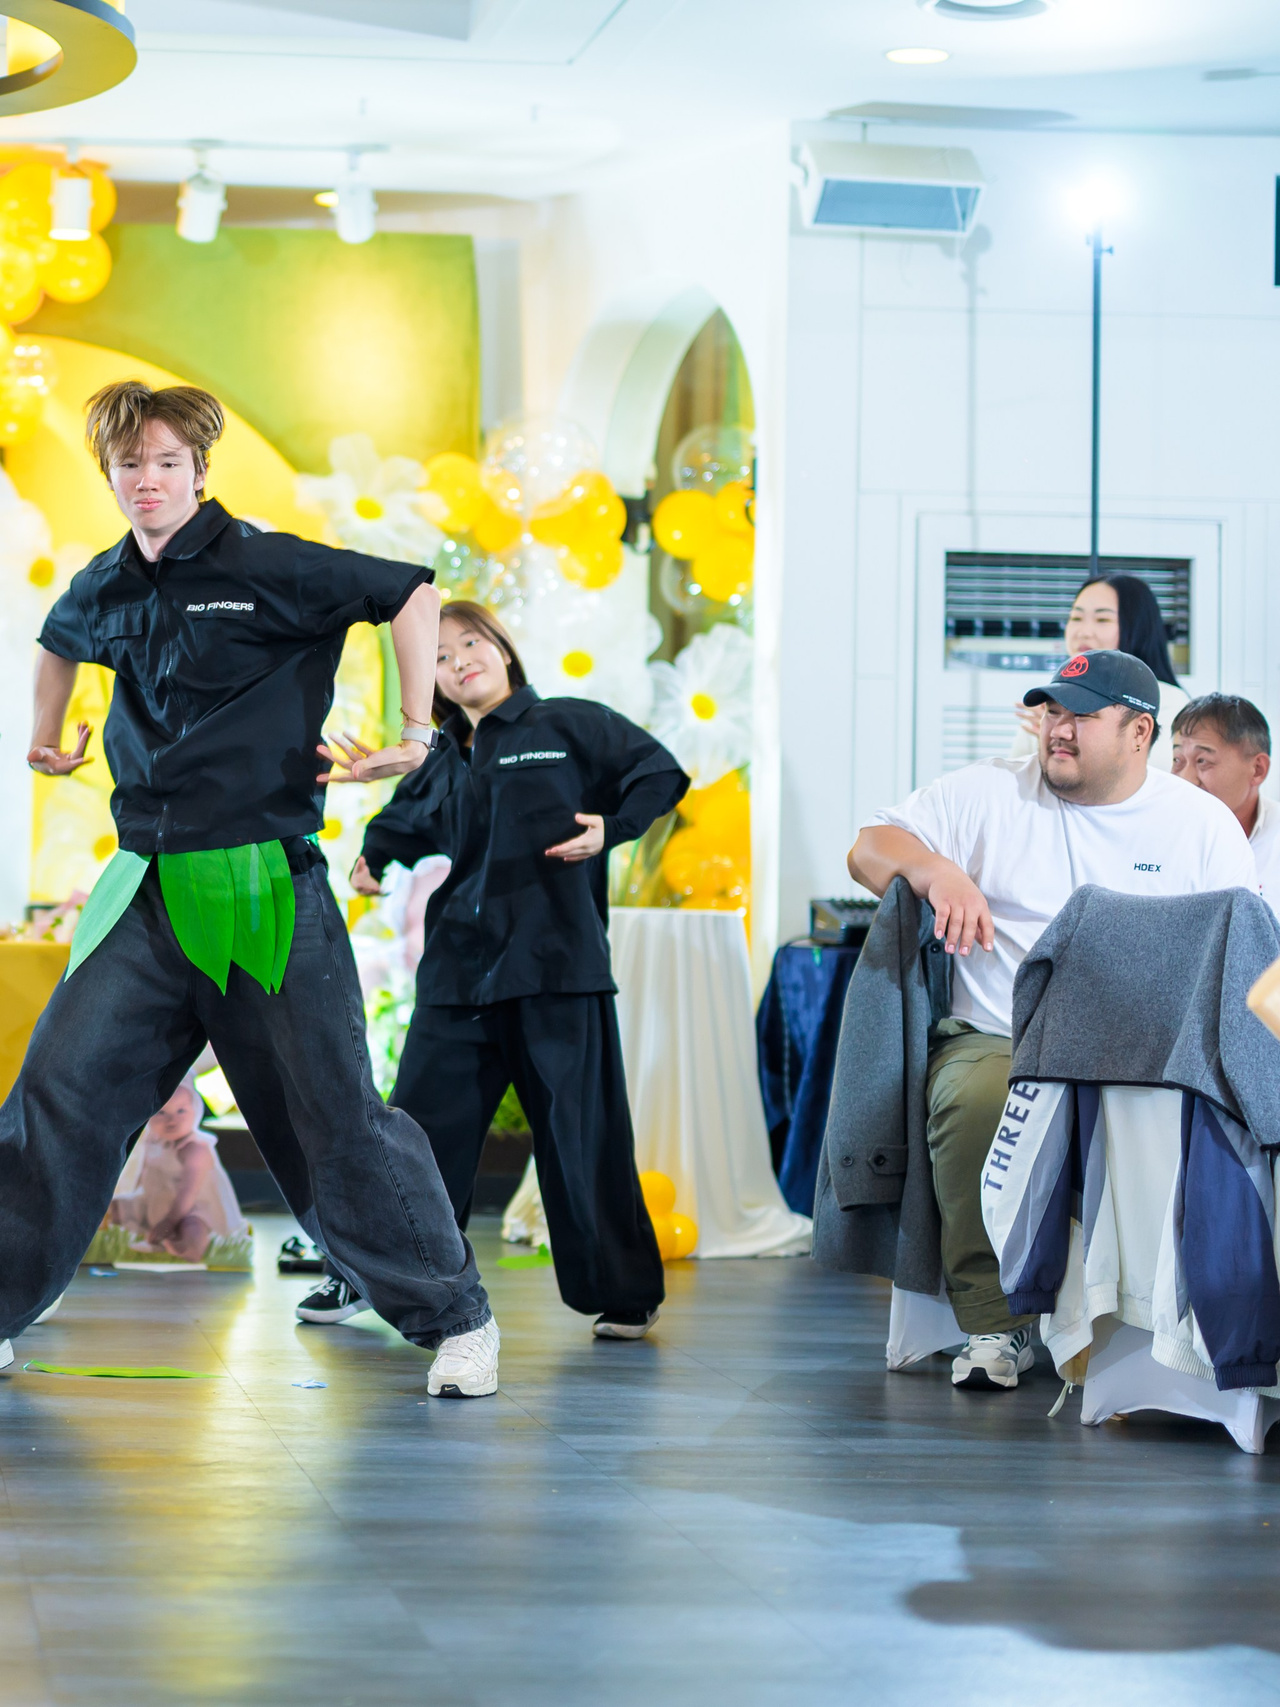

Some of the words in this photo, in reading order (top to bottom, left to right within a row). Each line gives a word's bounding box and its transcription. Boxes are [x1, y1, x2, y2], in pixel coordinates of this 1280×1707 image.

[186, 603, 206, 612] BIG
[207, 600, 255, 611] FINGERS
[499, 755, 518, 765] BIG
[519, 751, 567, 762] FINGERS
[1133, 862, 1162, 873] HDEX
[983, 1081, 1041, 1191] THREE
